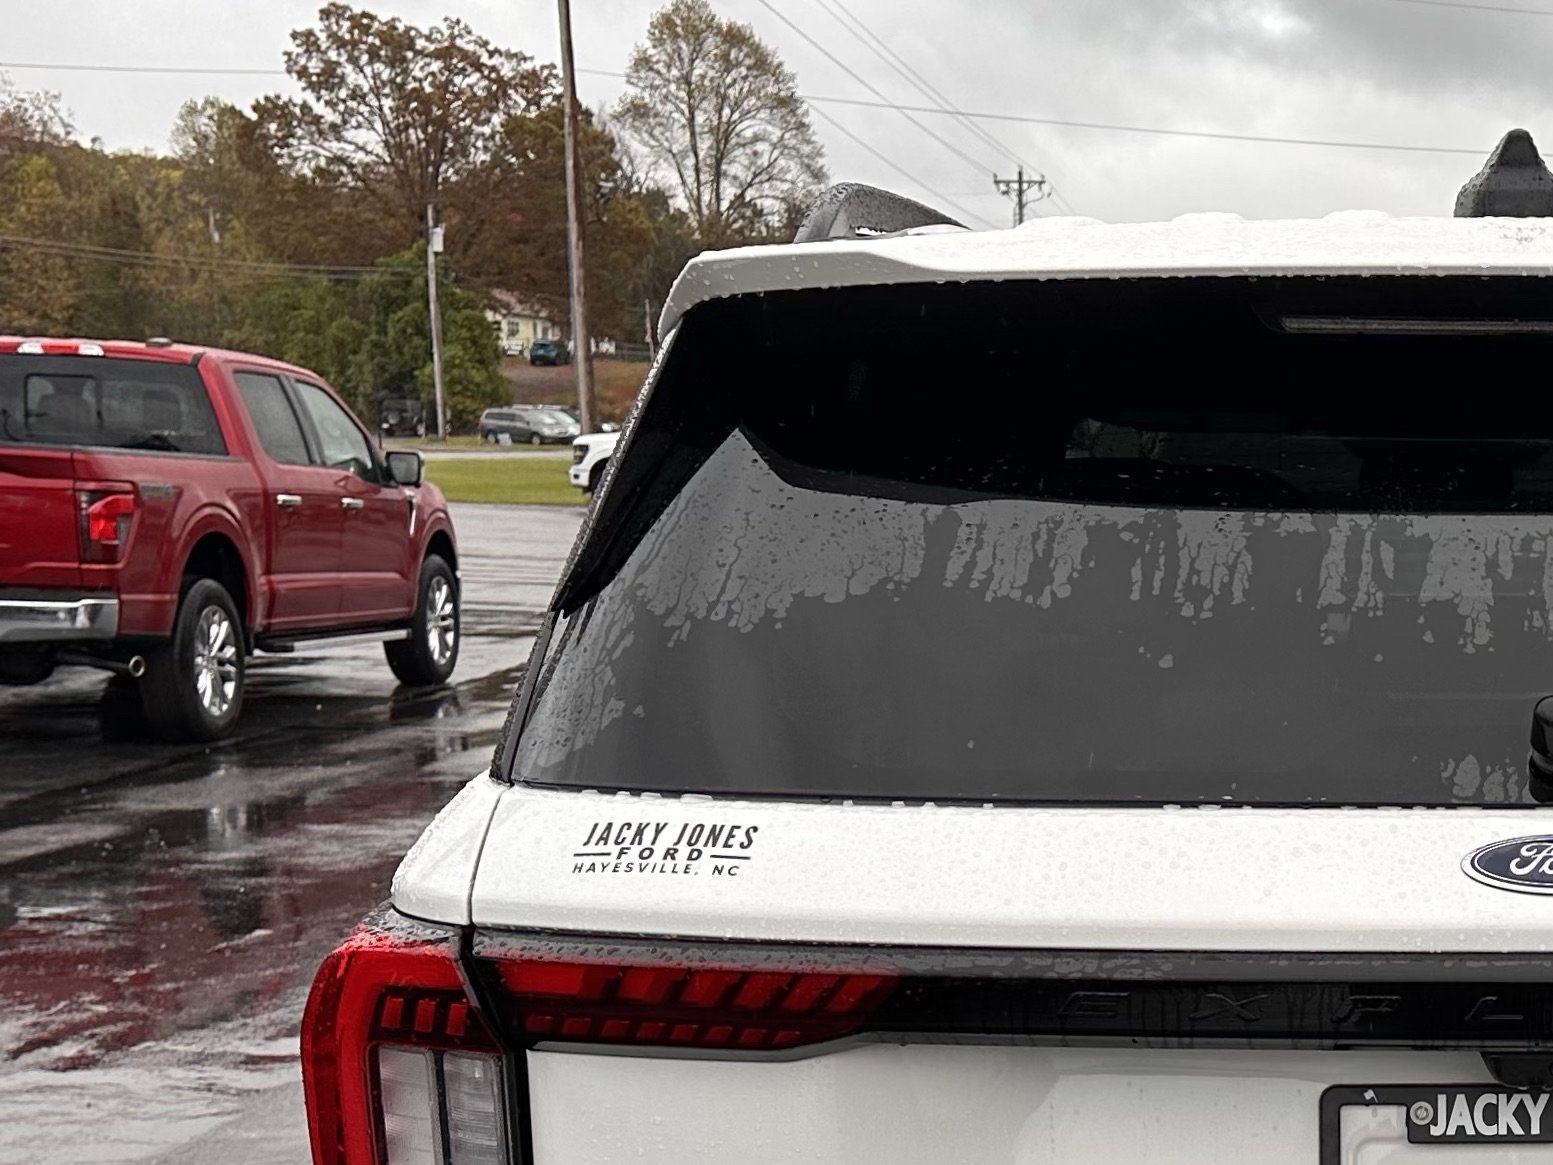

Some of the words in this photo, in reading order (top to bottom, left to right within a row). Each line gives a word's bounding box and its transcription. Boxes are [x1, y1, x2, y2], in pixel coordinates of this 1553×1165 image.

[582, 821, 669, 847] JACKY
[673, 822, 759, 850] JONES
[615, 846, 704, 862] FORD
[571, 861, 699, 876] HAYESVILLE,
[711, 864, 741, 877] NC
[1429, 1092, 1550, 1137] JACKY
